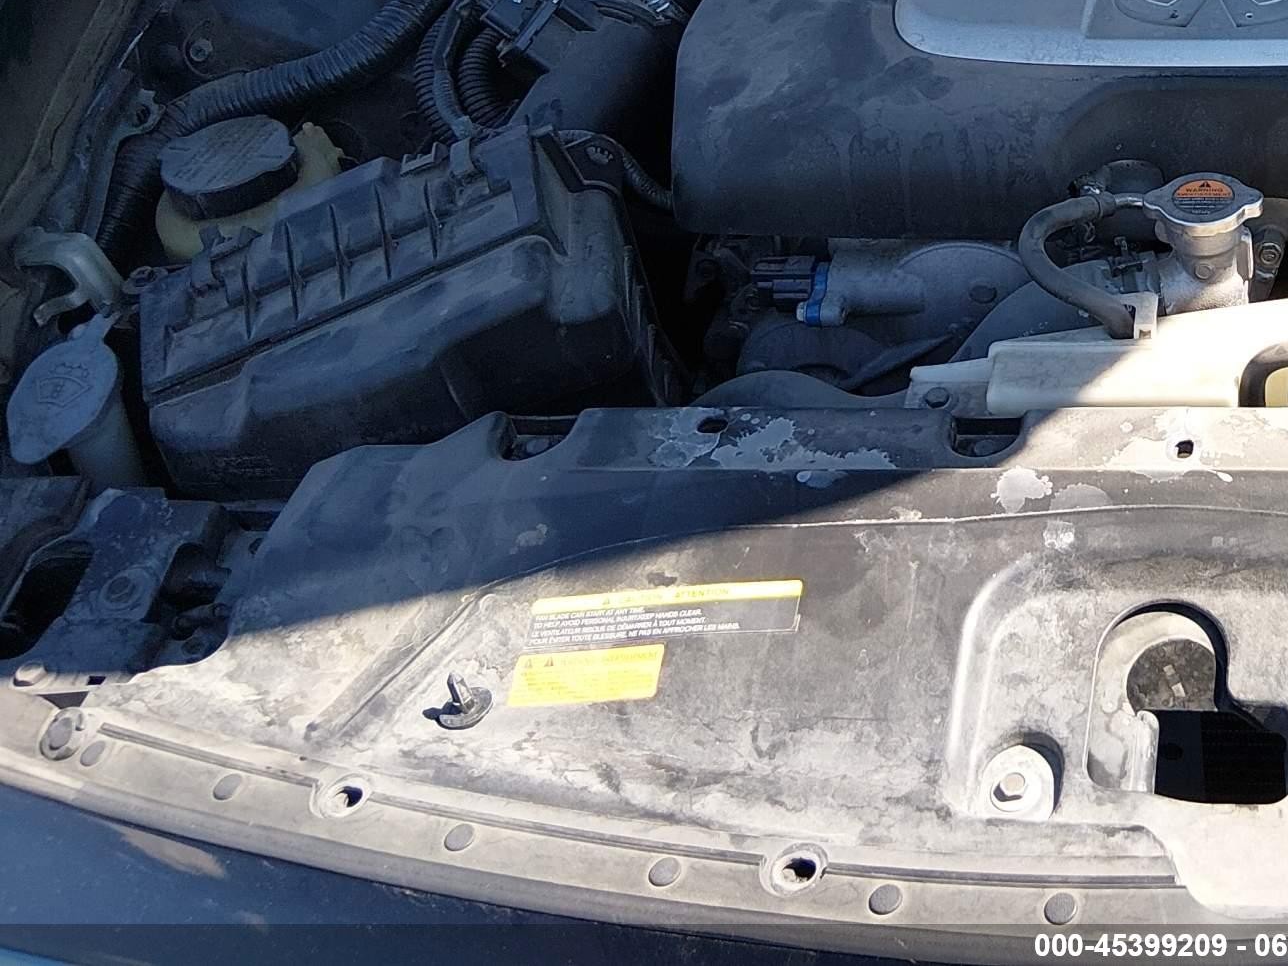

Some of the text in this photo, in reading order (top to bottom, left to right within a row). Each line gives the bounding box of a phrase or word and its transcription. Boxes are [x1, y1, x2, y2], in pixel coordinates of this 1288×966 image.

[614, 608, 629, 616] ANY
[543, 620, 560, 629] HELP
[559, 618, 581, 628] AVOID
[580, 615, 616, 626] PERSONAL
[658, 618, 676, 628] TOUT
